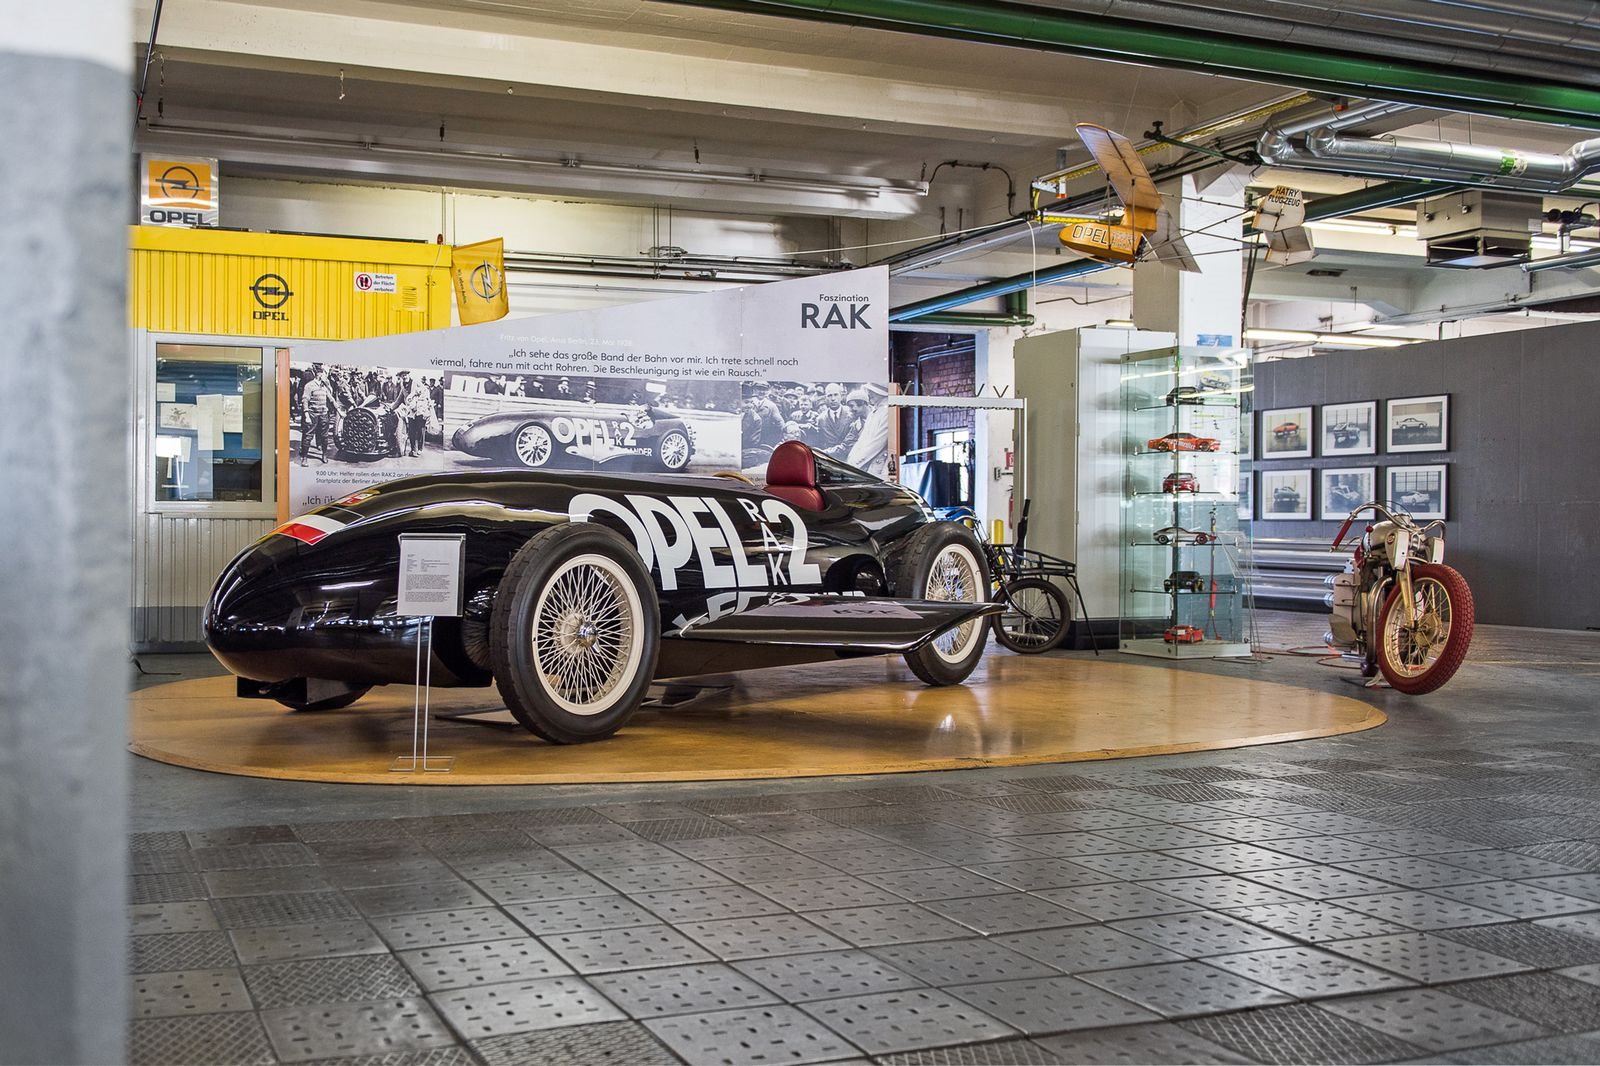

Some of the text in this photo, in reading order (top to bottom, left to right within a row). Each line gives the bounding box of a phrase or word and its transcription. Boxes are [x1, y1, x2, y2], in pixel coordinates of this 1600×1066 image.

[1275, 186, 1299, 198] HATRY
[150, 210, 211, 226] OPEL
[1072, 224, 1108, 246] OPEL
[819, 293, 869, 303] Faszination
[252, 311, 290, 321] OPEL
[801, 303, 872, 330] RAK
[430, 358, 467, 369] viermal,
[469, 358, 493, 369] fahre
[496, 361, 513, 369] nun
[516, 361, 530, 370] mit
[533, 362, 553, 371] acht
[556, 363, 590, 373] Rohren.
[593, 364, 607, 374] Die
[609, 365, 680, 377] Beschleunigung
[682, 367, 692, 376] ist
[694, 368, 710, 376] wie
[712, 368, 726, 377] ein
[529, 349, 550, 359] sehe
[552, 350, 569, 359] das
[571, 351, 598, 362] große
[601, 353, 624, 362] Band
[626, 353, 642, 363] der
[644, 354, 667, 363] Bahn
[687, 355, 703, 364] mir.
[705, 356, 718, 364] Ich
[721, 357, 741, 365] trete
[744, 356, 775, 366] schnell
[777, 357, 798, 366] noch
[551, 417, 614, 447] OPEL
[611, 421, 623, 446] RAK
[620, 421, 637, 446] 2
[316, 477, 341, 485] Startplatz
[736, 498, 788, 586] RAK
[762, 499, 822, 585] 2
